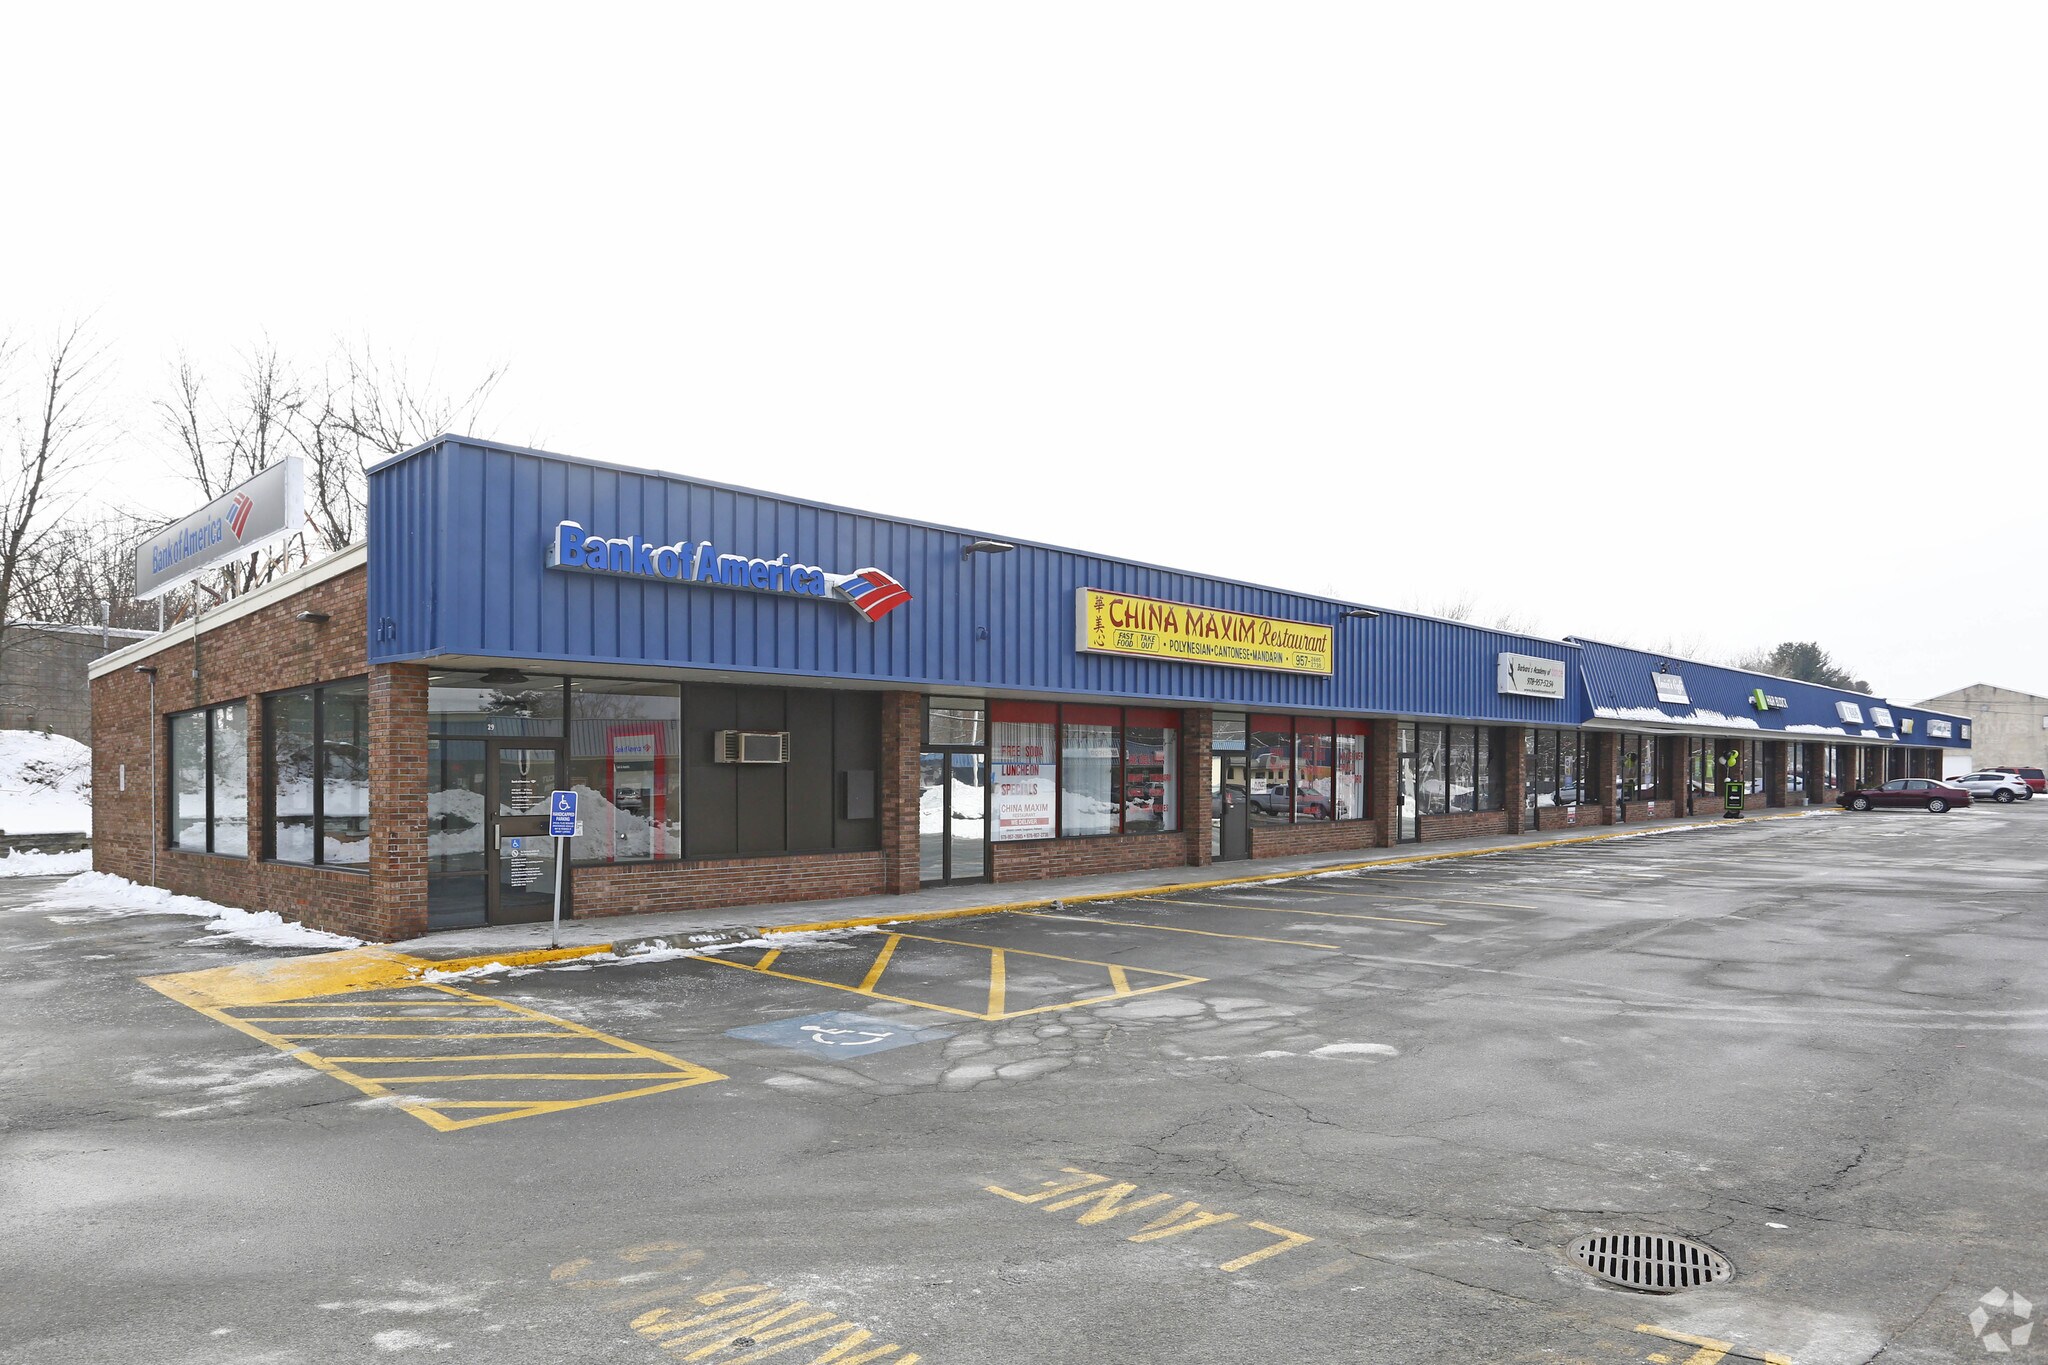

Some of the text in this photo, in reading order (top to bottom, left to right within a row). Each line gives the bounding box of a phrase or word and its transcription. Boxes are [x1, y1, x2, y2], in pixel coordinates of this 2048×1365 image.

[153, 516, 222, 573] Bank of America
[556, 522, 826, 596] Bank of America
[1109, 598, 1328, 653] CHINA MAXIM Restaurant
[1118, 632, 1134, 640] FAST
[1140, 634, 1156, 642] TAKE
[1117, 639, 1134, 647] FOOD
[487, 723, 495, 731] 29
[1001, 745, 1044, 757] FREE SODA
[1001, 764, 1040, 776] LUNCHEON
[1001, 803, 1048, 813] CHINA MAXIM
[983, 1166, 1316, 1273] LANE
